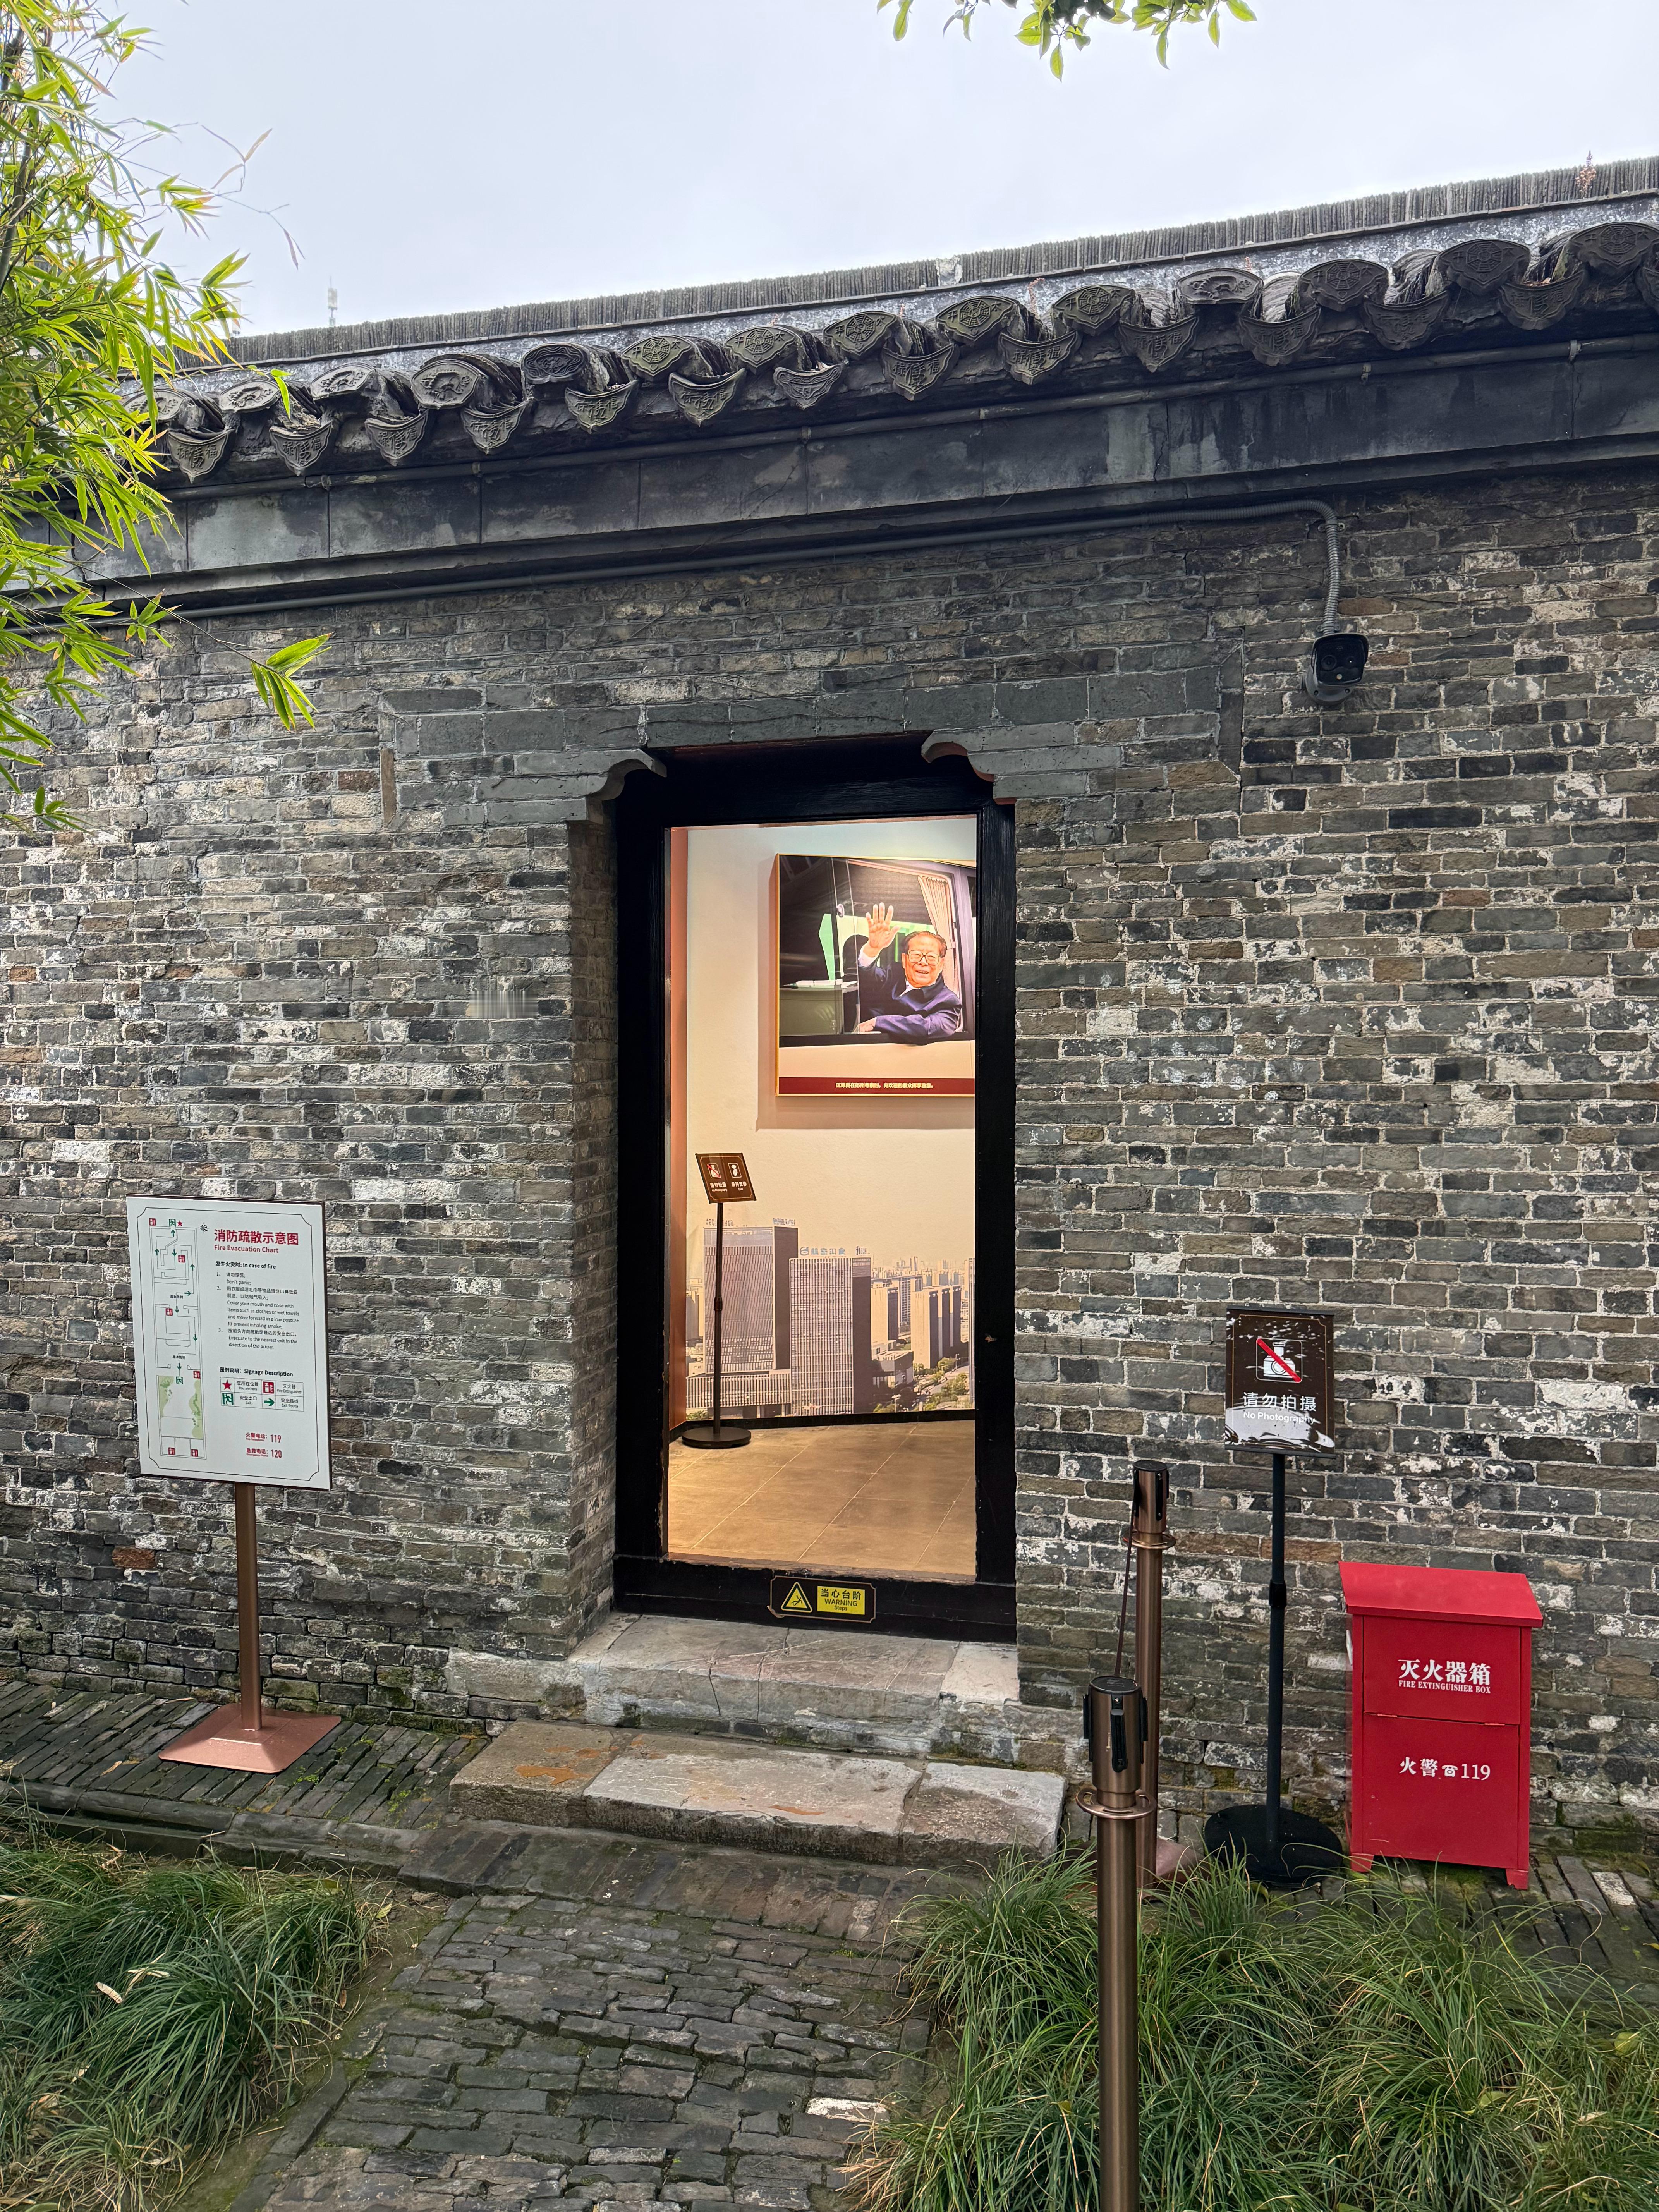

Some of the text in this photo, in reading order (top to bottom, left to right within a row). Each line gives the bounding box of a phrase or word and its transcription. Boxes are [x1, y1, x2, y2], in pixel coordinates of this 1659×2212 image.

[214, 1229, 299, 1245] 消防疏散示意图
[1243, 1392, 1316, 1412] 请勿拍摄
[1257, 1412, 1316, 1425] Photography
[270, 1434, 281, 1443] 119
[271, 1449, 282, 1458] 120
[821, 1588, 861, 1600] 当心台阶
[824, 1598, 857, 1606] WARNING
[1398, 1659, 1491, 1685] 灭火器箱
[1398, 1680, 1491, 1694] FIRE EXTINGUISHER BOX
[1399, 1757, 1491, 1781] 火警 119
